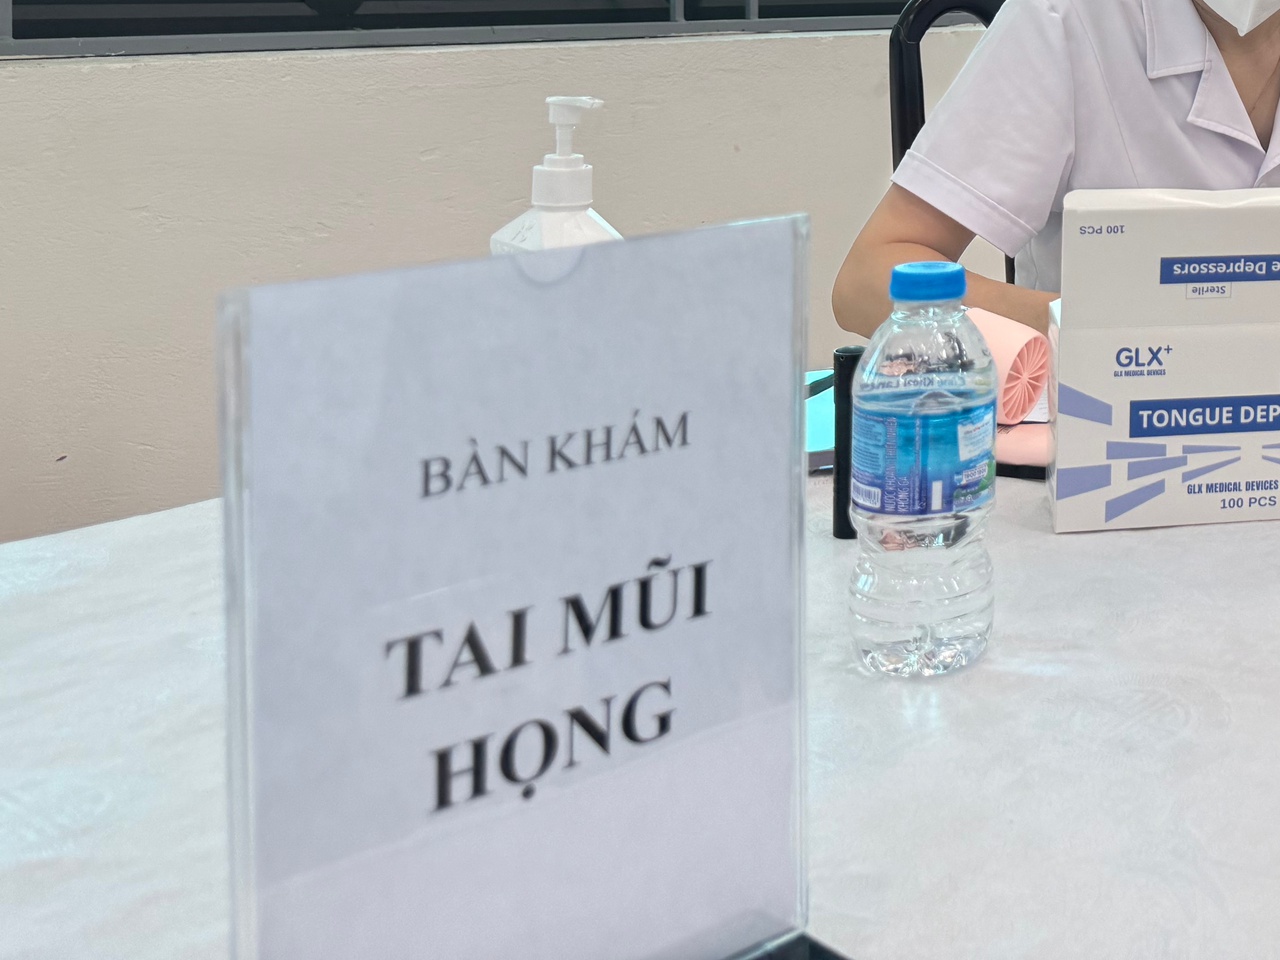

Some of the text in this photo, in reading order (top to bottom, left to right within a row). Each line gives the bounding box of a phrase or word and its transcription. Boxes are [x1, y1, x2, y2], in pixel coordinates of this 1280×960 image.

[1079, 224, 1125, 235] 100 PCS
[1173, 258, 1267, 276] Depressors
[1191, 285, 1227, 295] Sterile
[1124, 369, 1146, 377] MEDICAL
[1146, 368, 1166, 376] DEVICES
[1138, 406, 1233, 429] TONGUE
[417, 408, 693, 500] BÀN KHÁM
[1186, 484, 1203, 495] GLX
[1205, 481, 1243, 494] MEDICAL
[1244, 479, 1279, 493] DEVICES
[1220, 495, 1277, 510] 100 PCS
[385, 554, 715, 702] TAI MŨI
[429, 677, 678, 814] HỌNG
